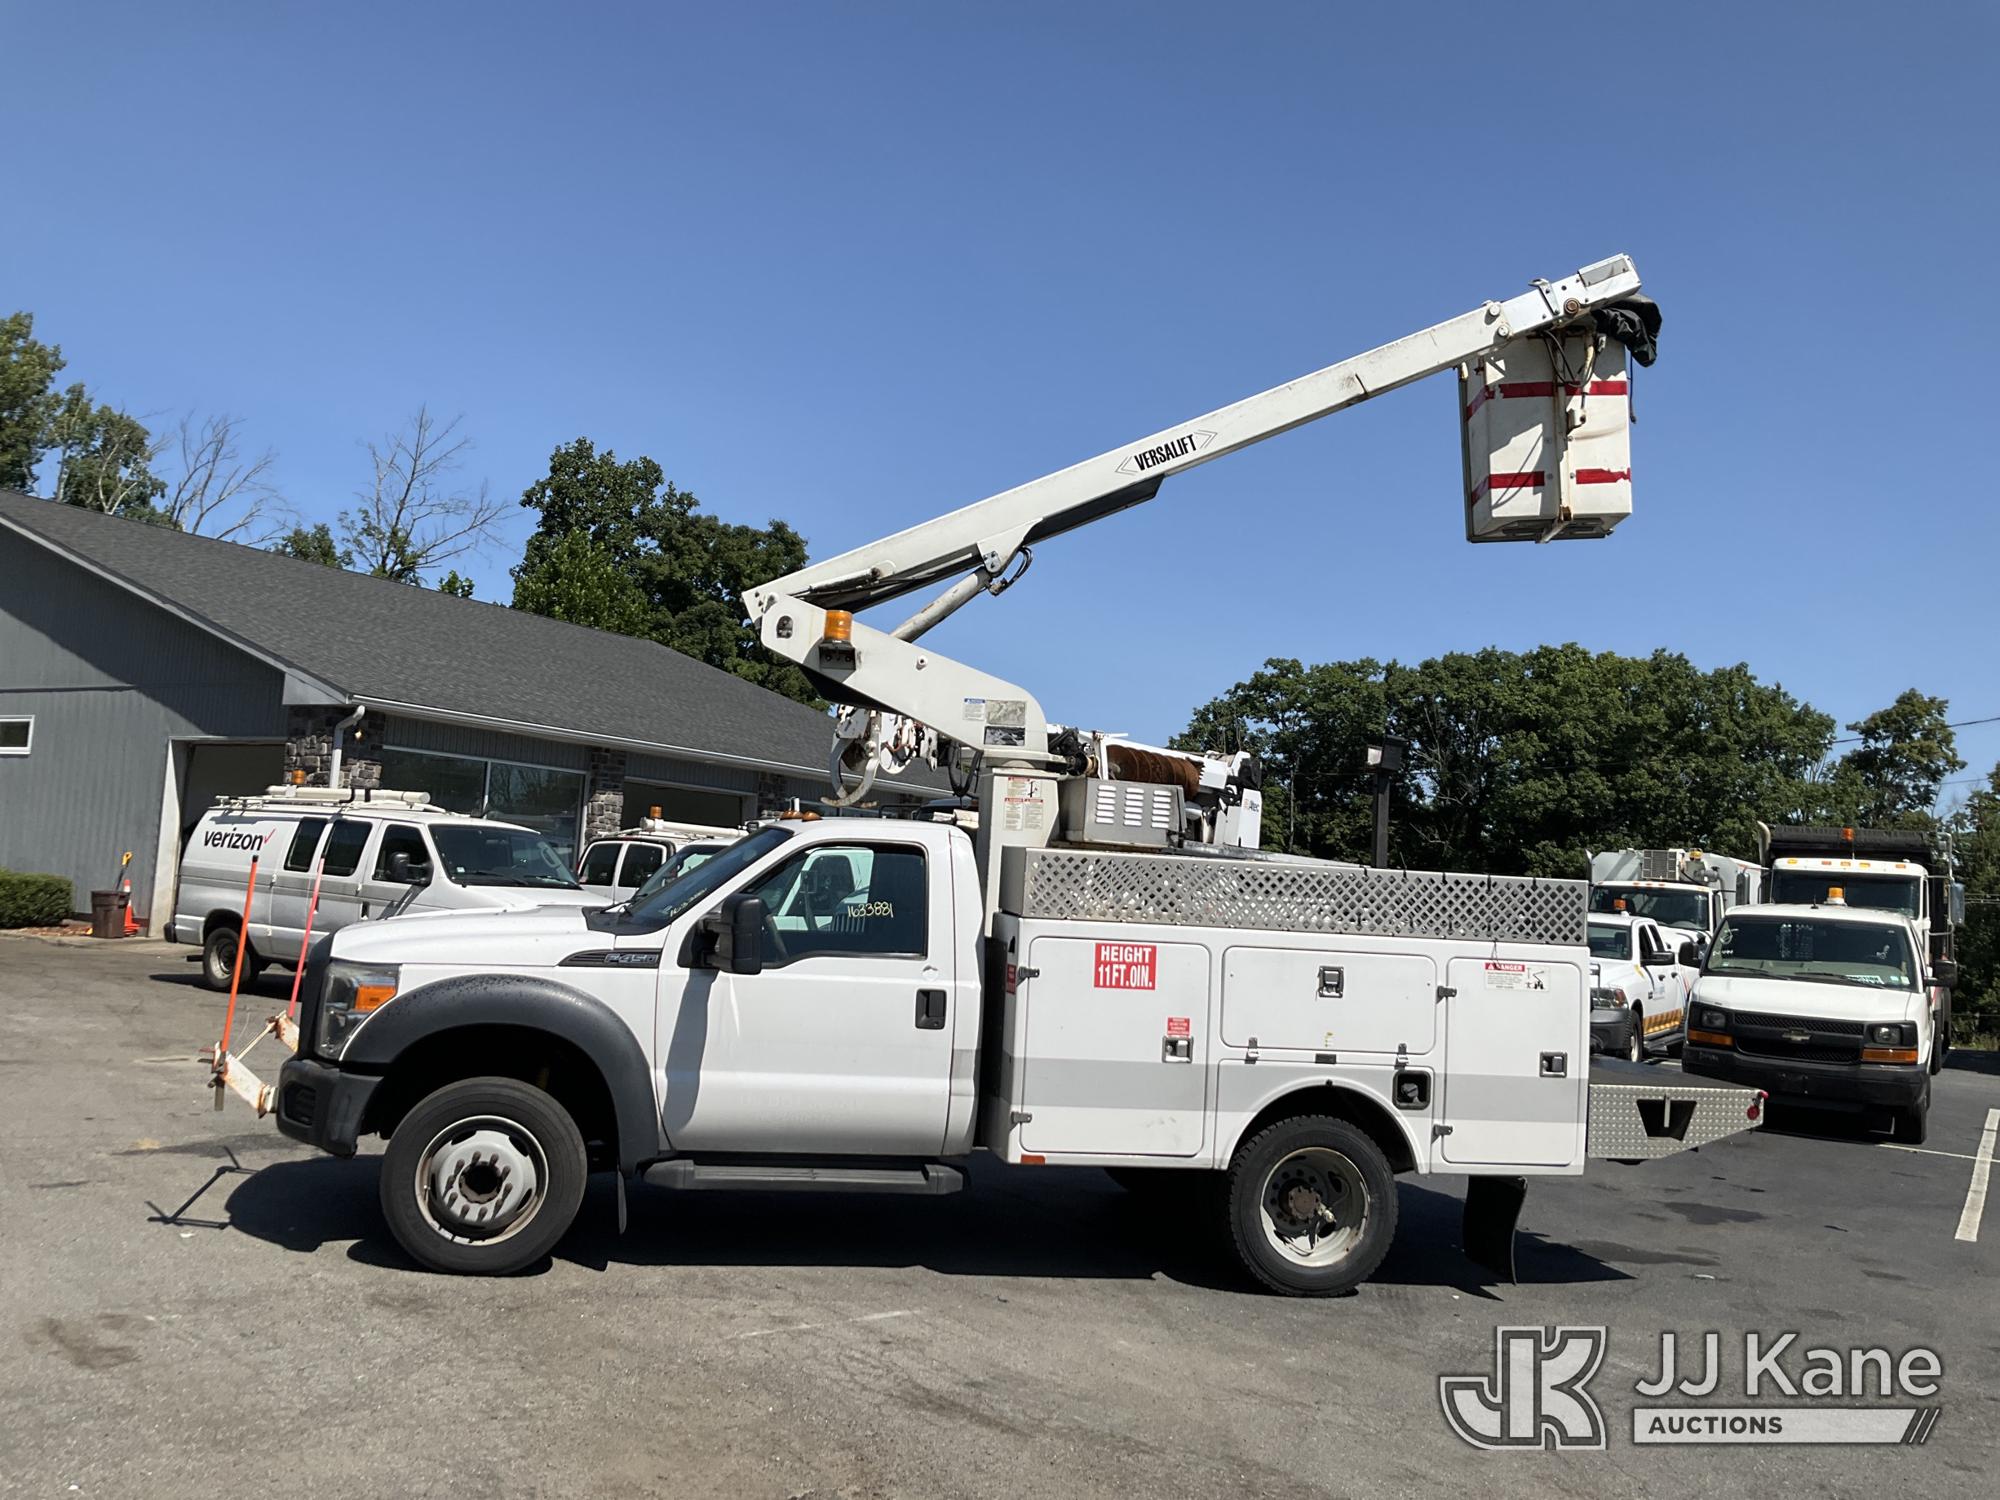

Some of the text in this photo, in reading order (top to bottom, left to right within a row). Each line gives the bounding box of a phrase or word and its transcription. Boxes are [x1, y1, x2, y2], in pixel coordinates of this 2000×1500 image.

[1133, 433, 1197, 471] VERSALIFT
[203, 827, 264, 851] verizon
[847, 901, 894, 918] 1633881
[1100, 945, 1152, 963] HEIGHT
